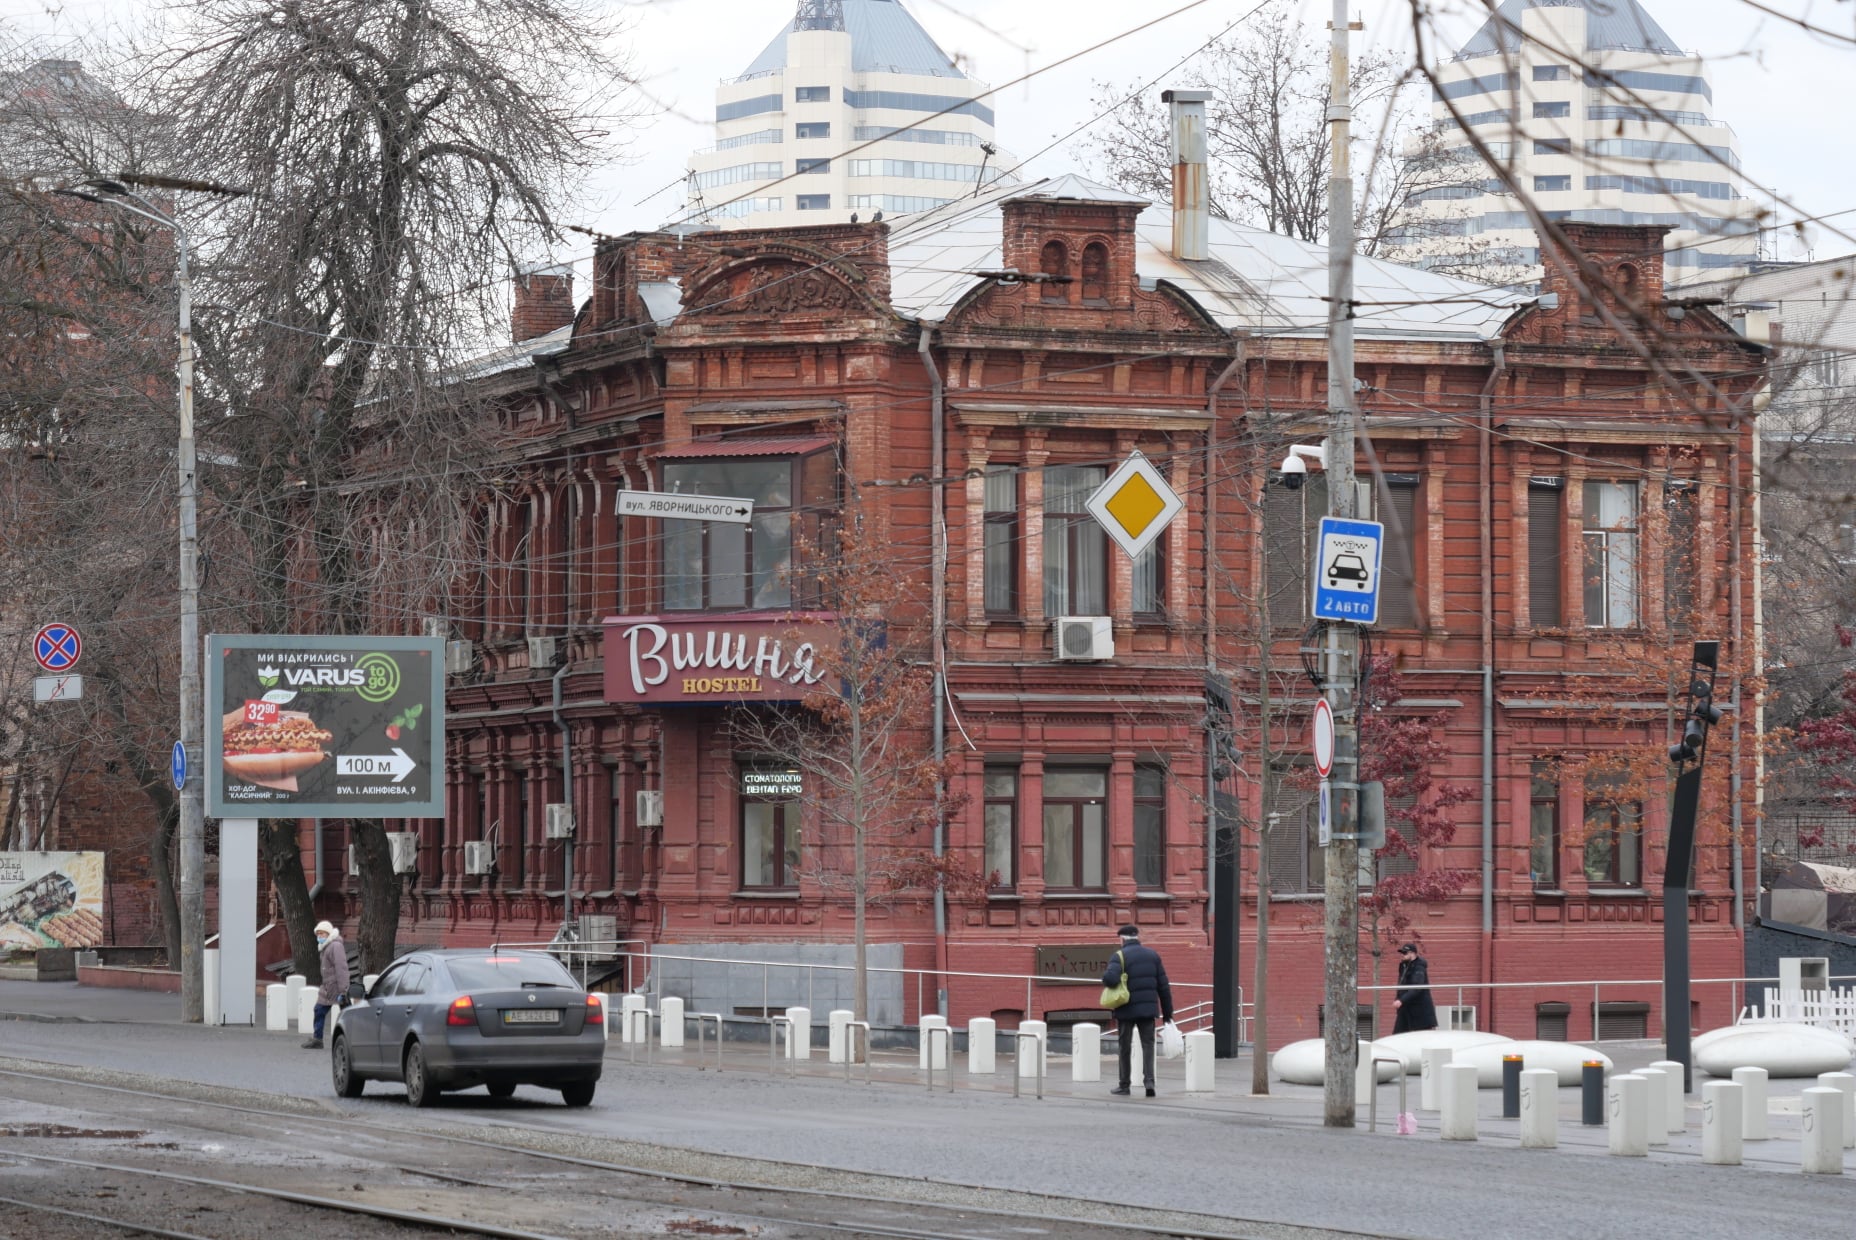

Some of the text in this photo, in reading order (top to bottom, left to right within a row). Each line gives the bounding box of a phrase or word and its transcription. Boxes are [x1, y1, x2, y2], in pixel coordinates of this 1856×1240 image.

[626, 500, 733, 515] вул. ЯВОРНИЦЬКОГО
[1324, 597, 1369, 614] 2 АВТО
[257, 654, 274, 662] МИ
[278, 654, 347, 663] ВІДКРИЛИСЬ
[622, 623, 826, 694] Вишня
[284, 668, 365, 686] VARUS
[369, 665, 385, 677] to
[368, 676, 386, 689] go
[682, 676, 763, 694] HOSTEL
[345, 758, 374, 773] 100
[336, 786, 353, 795] ВУЛ.
[411, 786, 416, 794] 9
